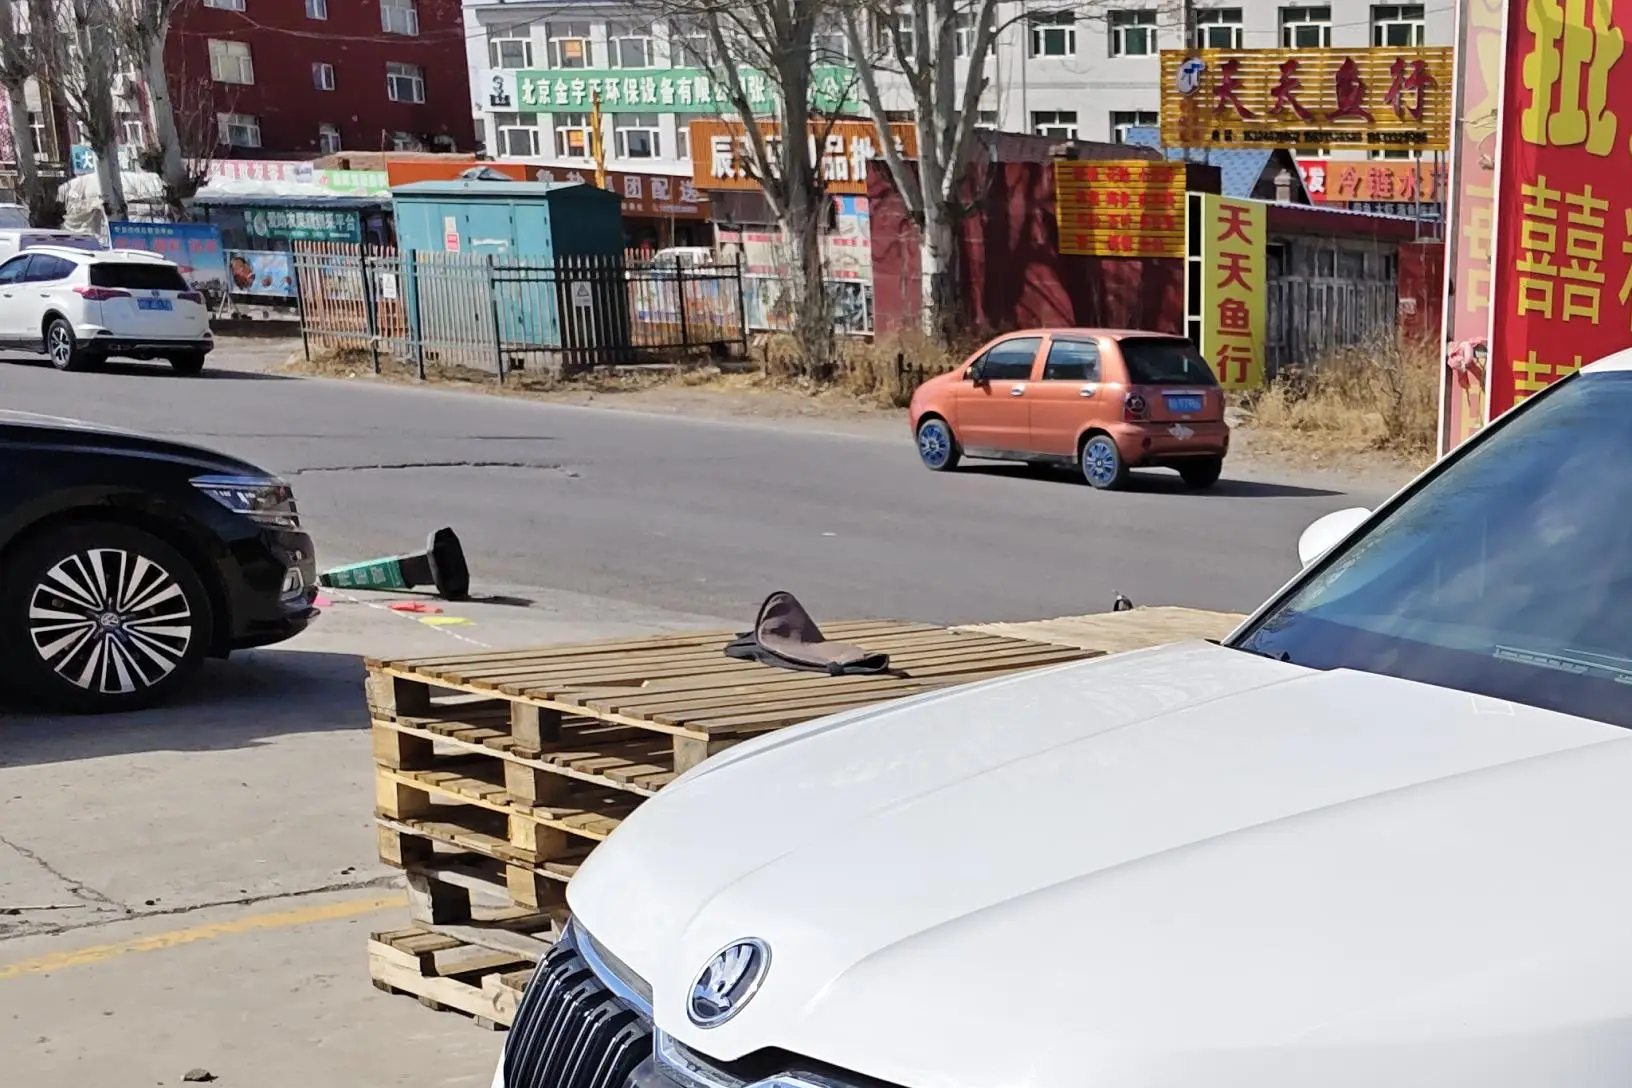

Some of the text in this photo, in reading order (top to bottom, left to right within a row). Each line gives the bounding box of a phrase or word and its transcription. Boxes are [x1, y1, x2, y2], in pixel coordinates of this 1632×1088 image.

[1212, 55, 1439, 123] 天天鱼行
[1217, 203, 1254, 384] 天天鱼行
